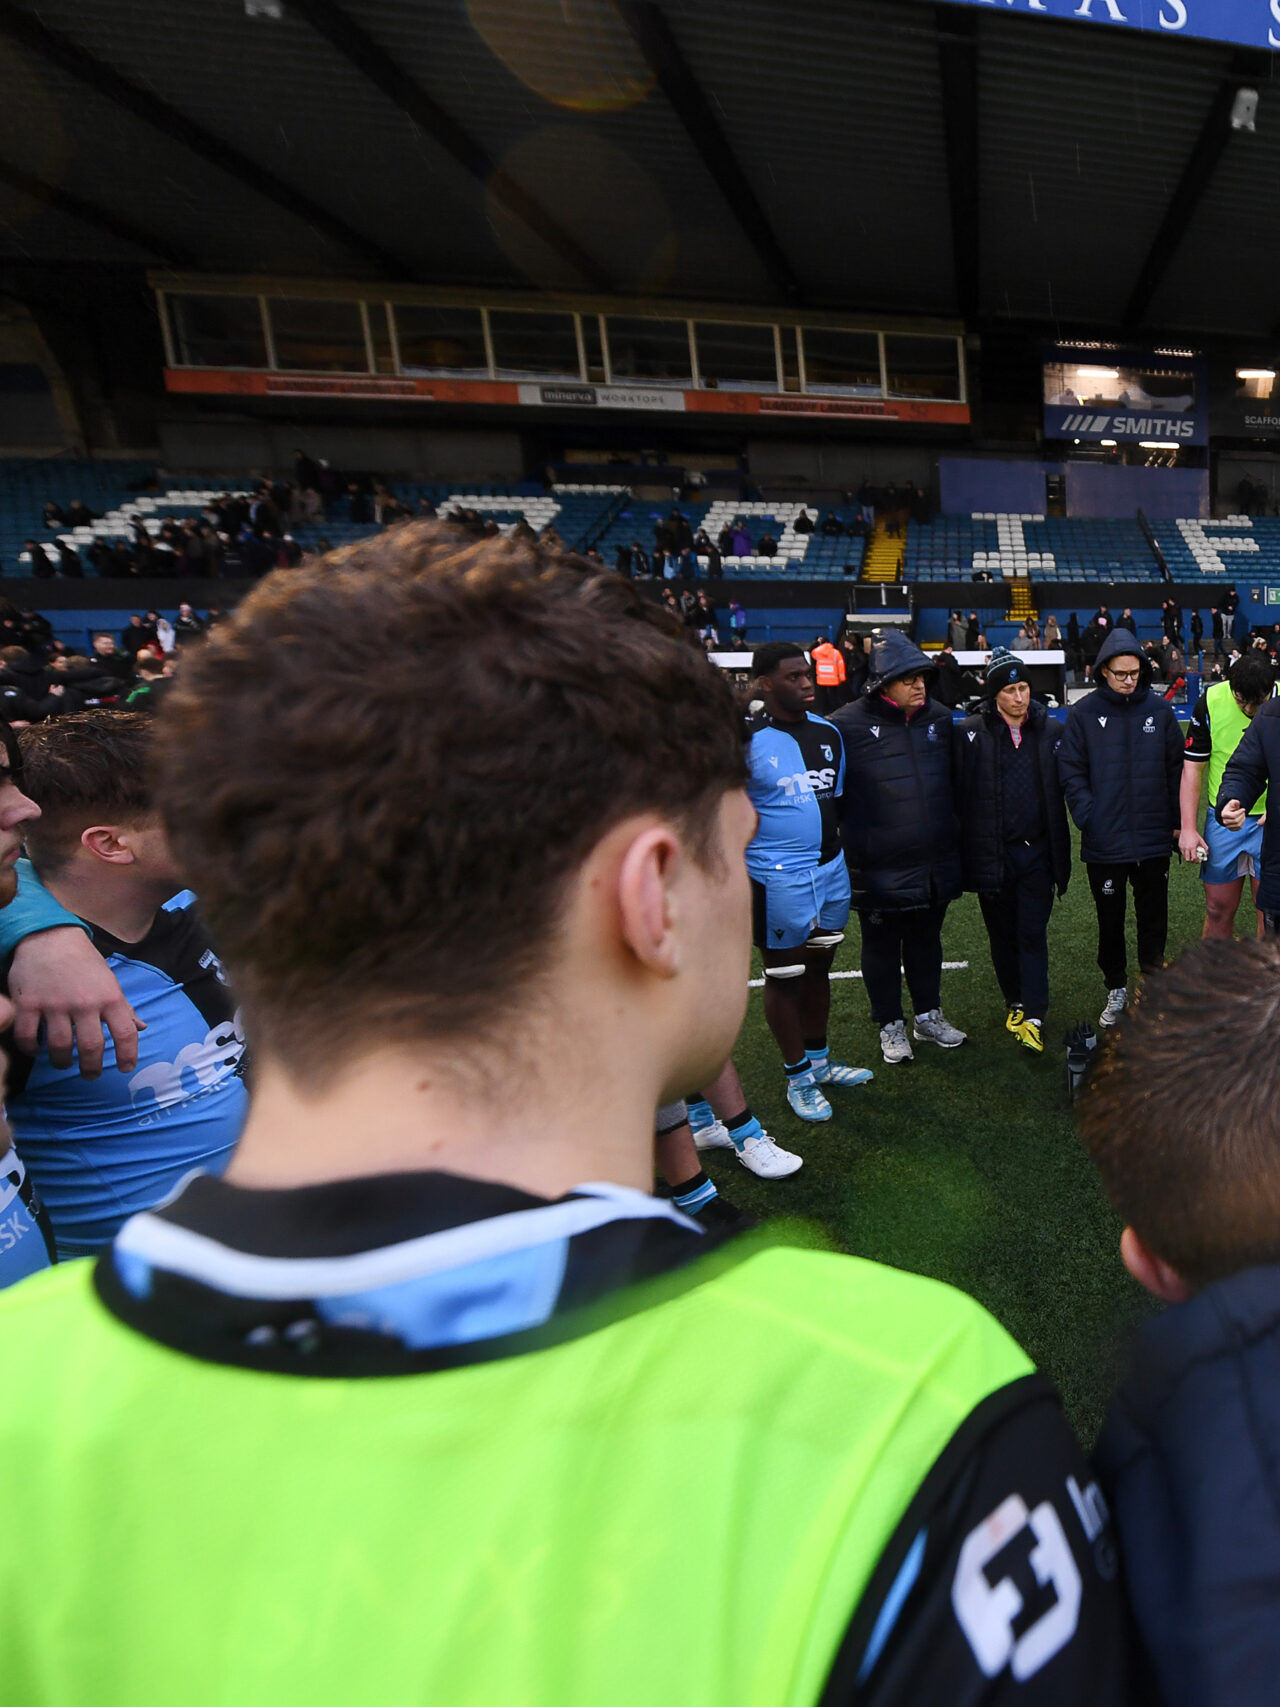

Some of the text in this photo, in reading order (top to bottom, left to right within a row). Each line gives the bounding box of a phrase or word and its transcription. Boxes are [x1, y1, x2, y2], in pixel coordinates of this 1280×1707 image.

[543, 389, 594, 403] minerva
[1112, 416, 1194, 438] SMITHS
[0, 1211, 30, 1254] SK
